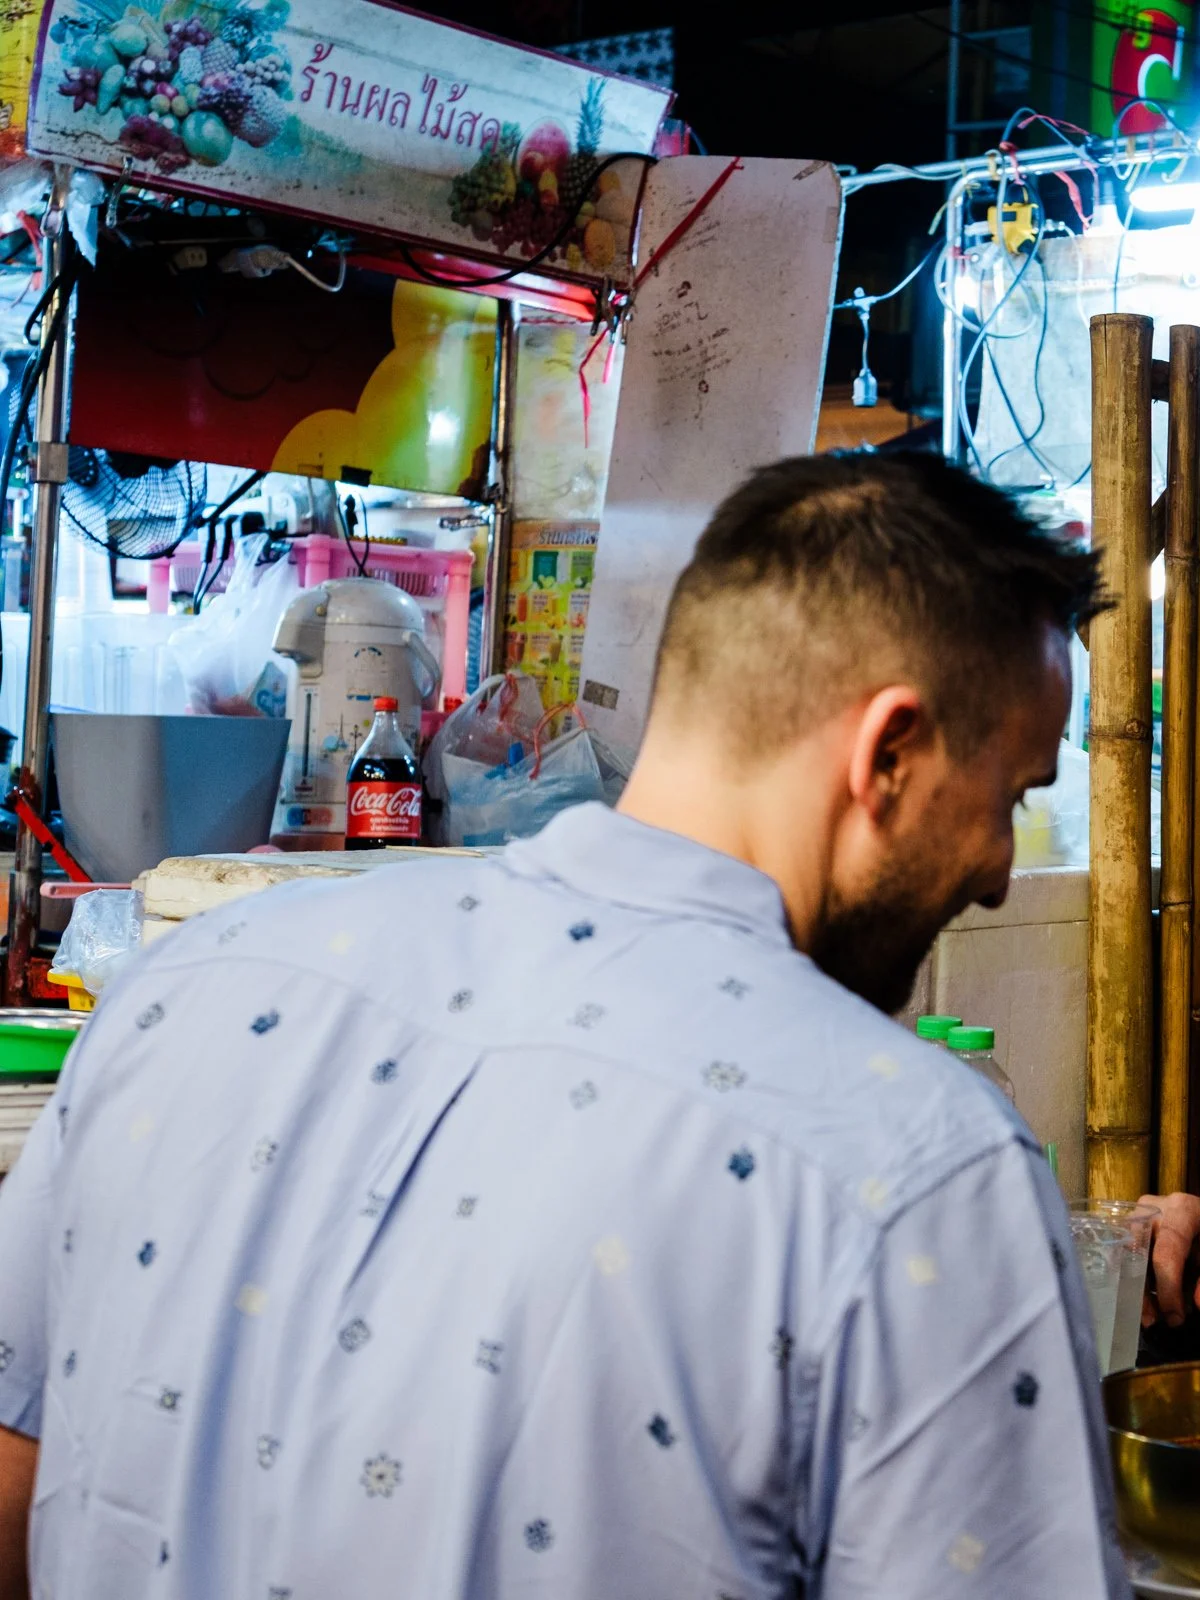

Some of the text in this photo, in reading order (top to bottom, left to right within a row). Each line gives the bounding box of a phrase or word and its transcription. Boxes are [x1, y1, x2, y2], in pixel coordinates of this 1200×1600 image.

[301, 43, 501, 154] ร้านผลไม้สด
[351, 786, 421, 817] Coca-Cola
